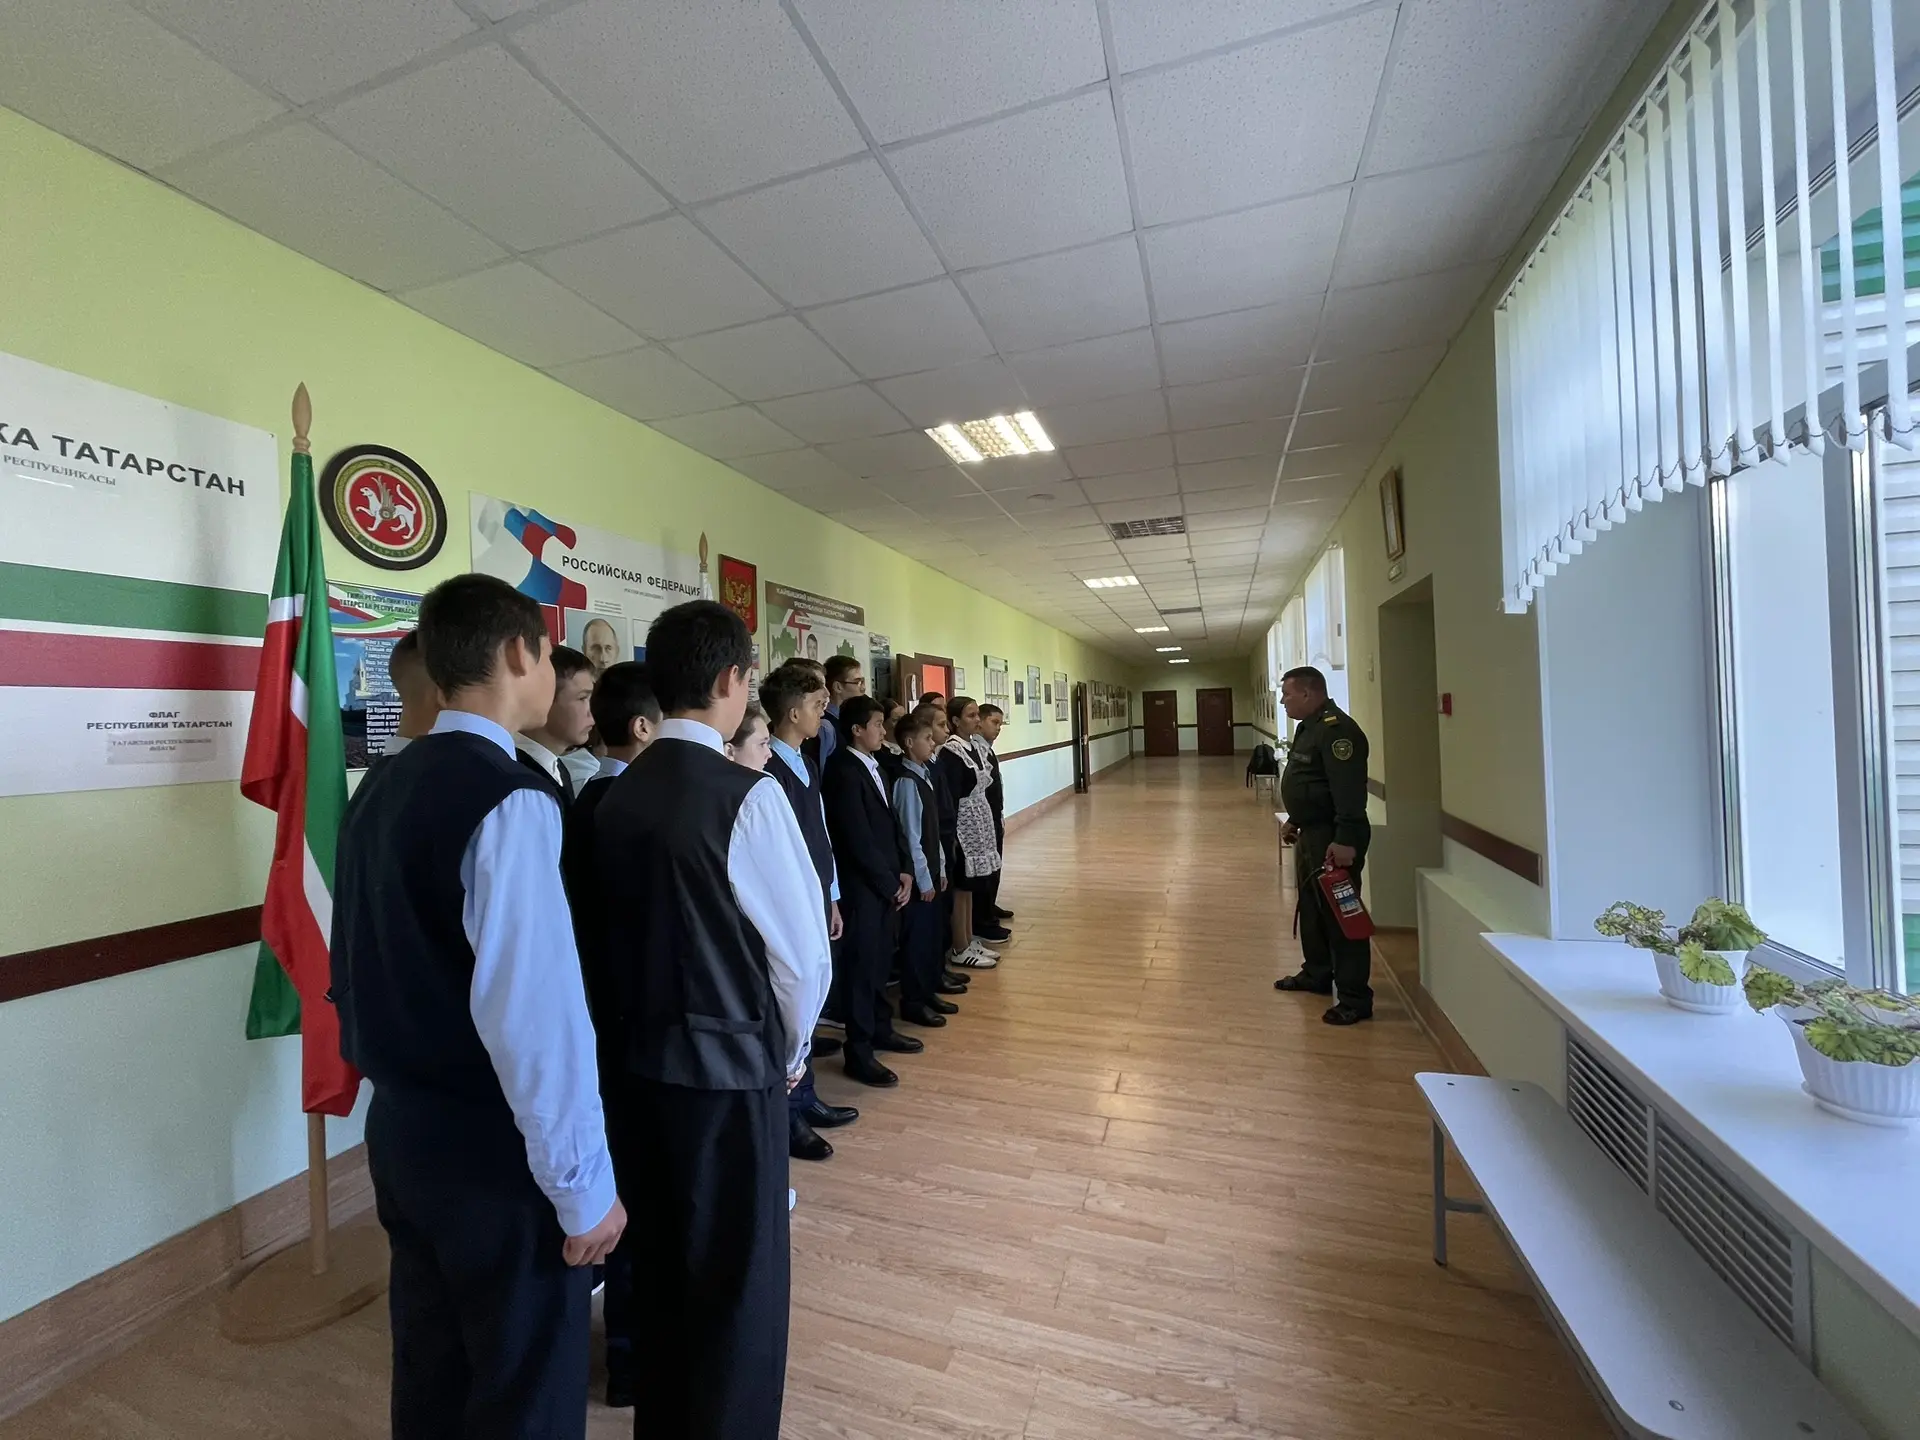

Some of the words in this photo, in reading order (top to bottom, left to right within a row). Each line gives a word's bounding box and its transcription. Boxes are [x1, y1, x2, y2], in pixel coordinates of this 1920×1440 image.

[3, 454, 117, 487] РЕСПУБЛИКАСЫ
[52, 434, 245, 497] ТАТАРСТАН
[562, 555, 642, 583] РОССИЙСКАЯ
[646, 575, 701, 597] ФЕДЕРАЦИЯ
[86, 721, 169, 730] РЕСПУБЛИКИ
[171, 720, 233, 729] ТАТАРСТАН
[149, 711, 180, 719] ФЛАГ
